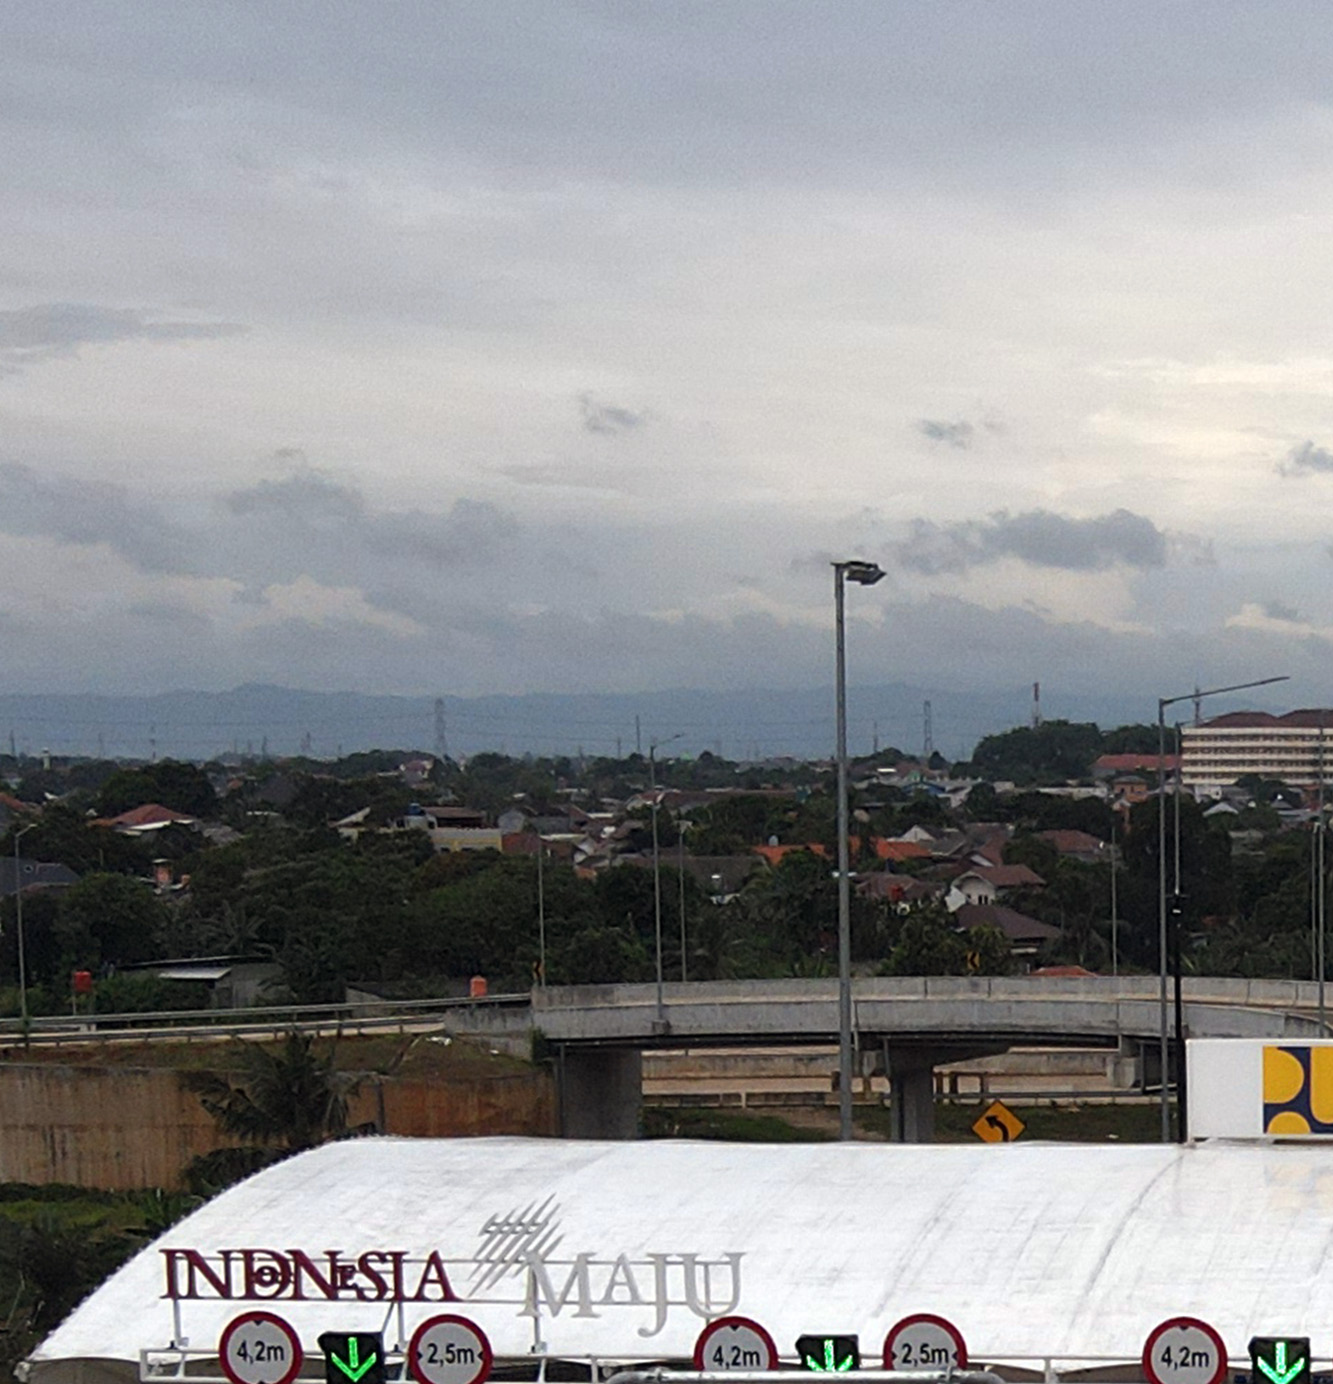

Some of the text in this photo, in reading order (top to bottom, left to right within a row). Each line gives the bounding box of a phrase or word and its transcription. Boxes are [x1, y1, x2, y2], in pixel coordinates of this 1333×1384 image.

[158, 1248, 464, 1301] INDONESIA
[516, 1250, 748, 1338] MAJU
[237, 1340, 284, 1365] 4,2m
[427, 1342, 475, 1367] 2,5m
[712, 1345, 761, 1370] 4,2m
[901, 1343, 949, 1368] 2,5m
[1160, 1345, 1209, 1371] 4,2m
